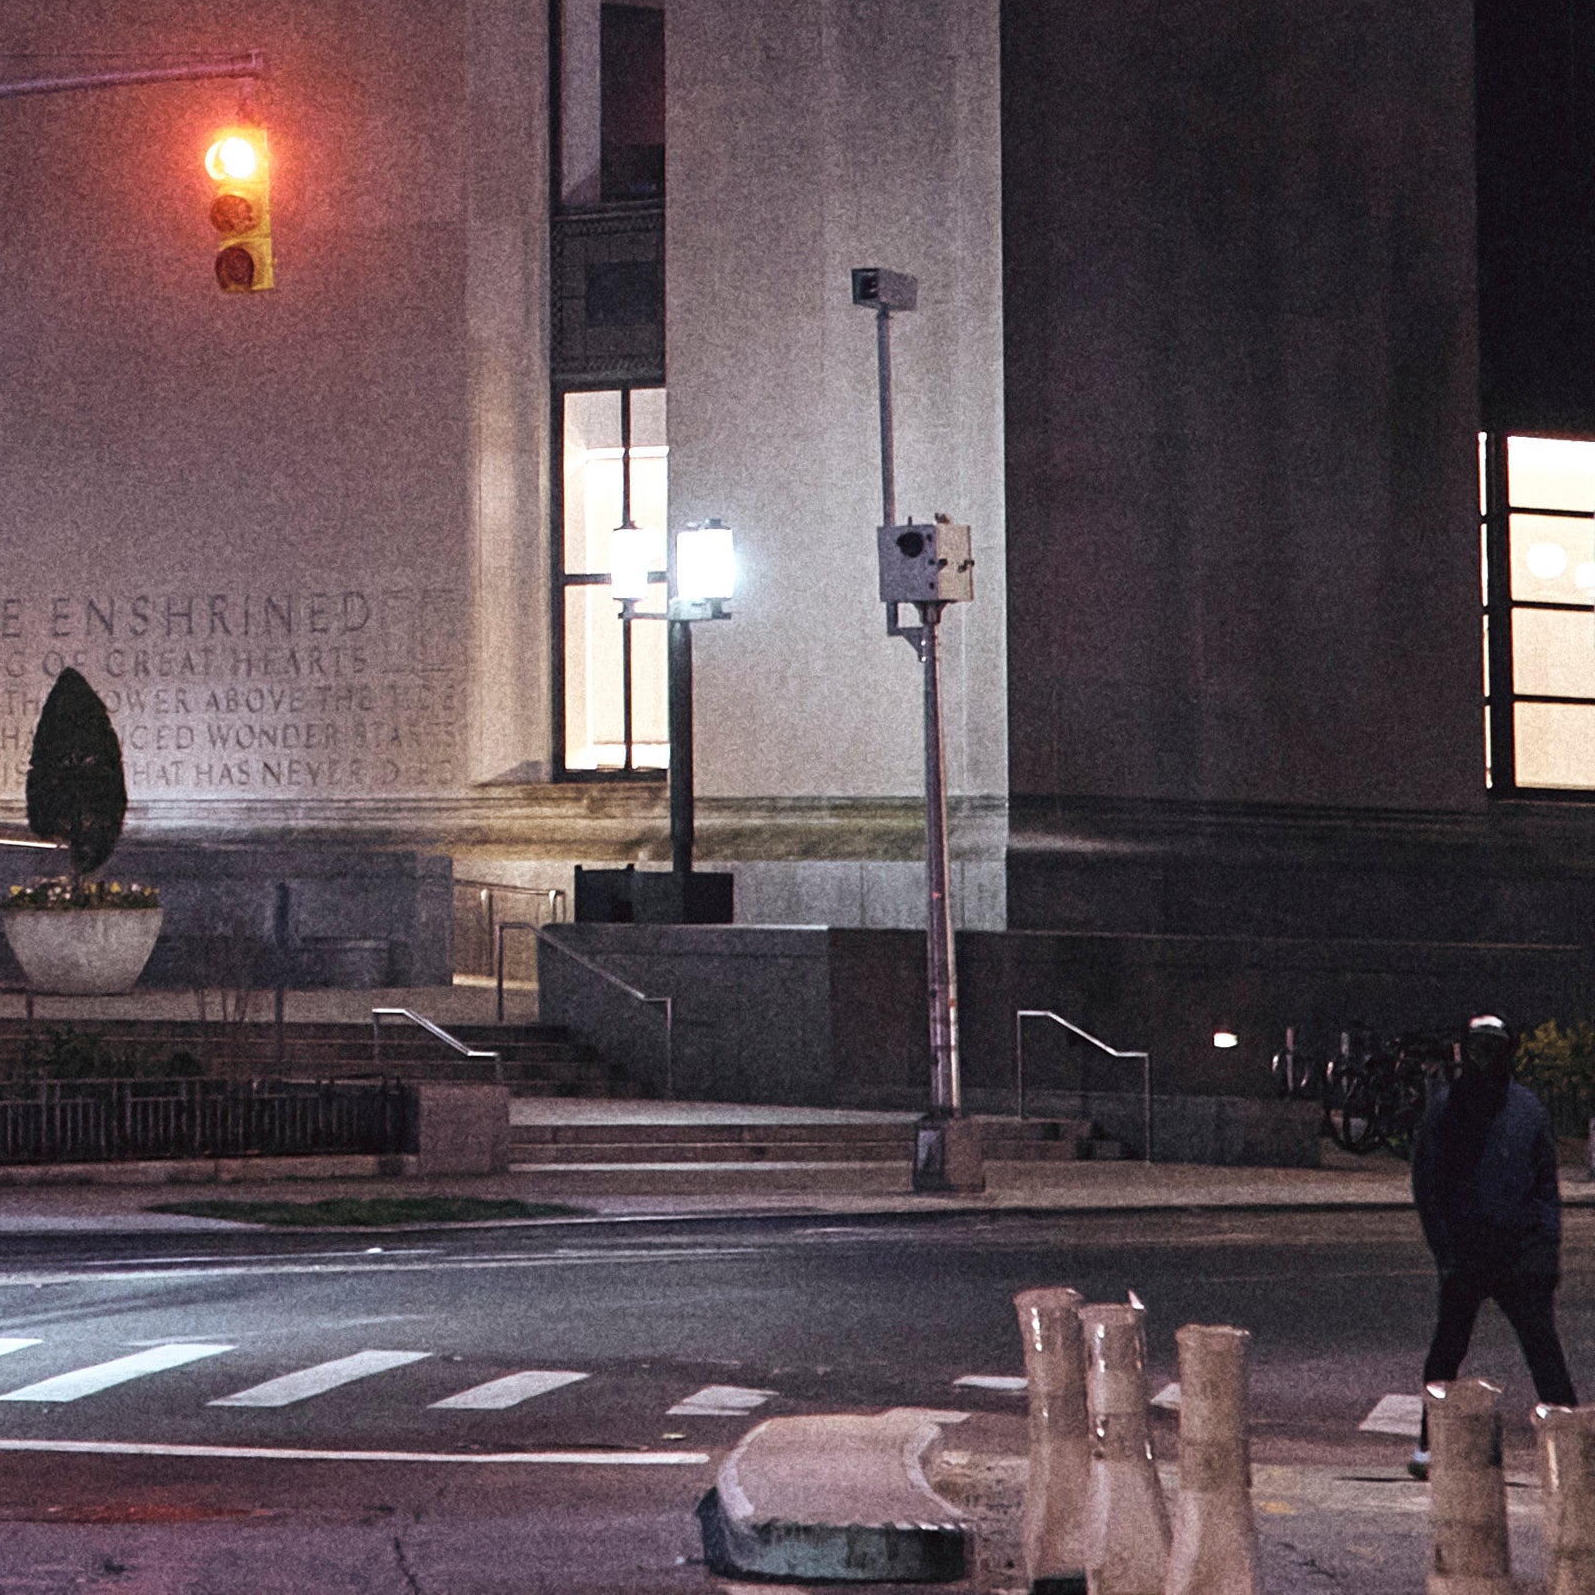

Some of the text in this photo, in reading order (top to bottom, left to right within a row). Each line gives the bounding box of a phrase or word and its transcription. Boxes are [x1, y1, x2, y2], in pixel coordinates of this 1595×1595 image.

[50, 590, 372, 639] ENSHRINED
[106, 647, 214, 678] GREAT
[231, 645, 367, 677] HEARTS
[106, 687, 192, 714] OWER
[205, 684, 306, 714] ABOVE
[207, 721, 339, 750] WONDER
[131, 758, 185, 788] HAT
[195, 758, 251, 787] HAS
[262, 757, 362, 786] NEVER
